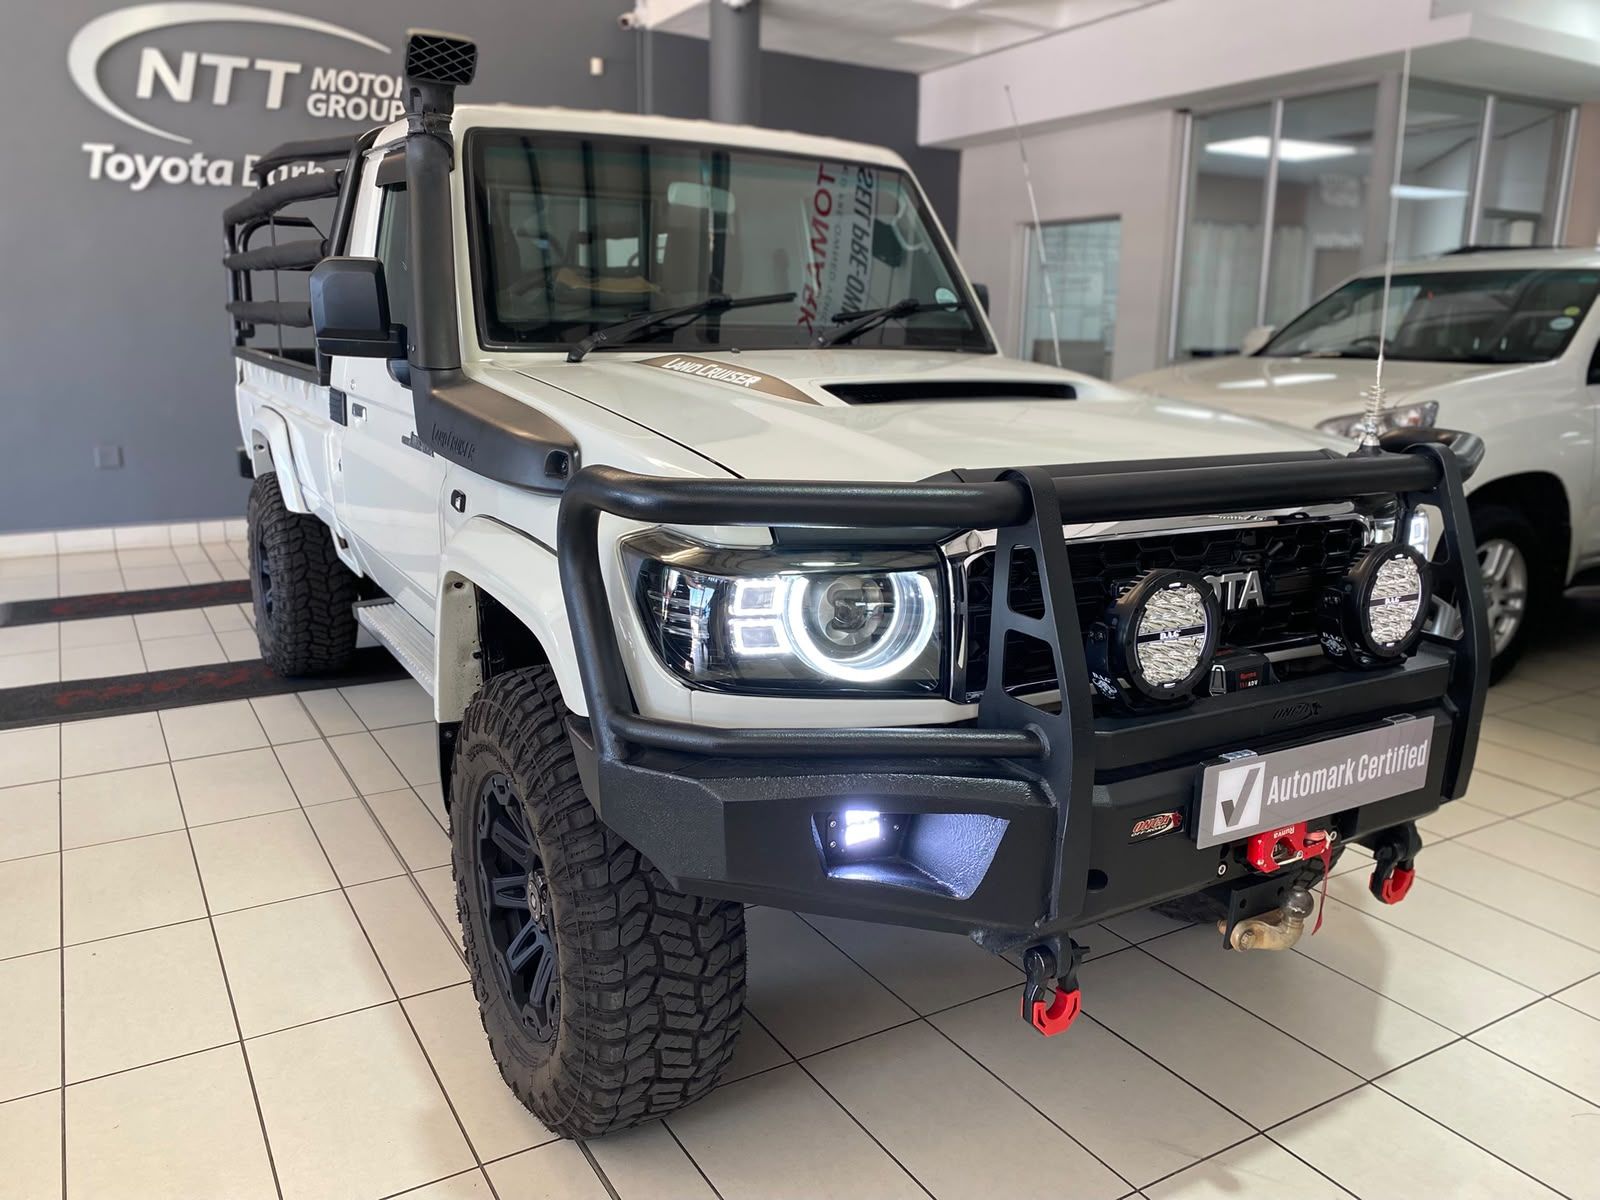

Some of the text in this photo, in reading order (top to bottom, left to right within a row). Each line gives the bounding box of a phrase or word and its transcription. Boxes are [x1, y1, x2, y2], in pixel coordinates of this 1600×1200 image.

[136, 46, 302, 110] NTT
[306, 92, 406, 123] GROUP
[81, 142, 235, 192] Toyota
[661, 357, 762, 388] LAND CRUISER
[1267, 739, 1429, 806] Automark Certified
[1273, 826, 1295, 839] Runva
